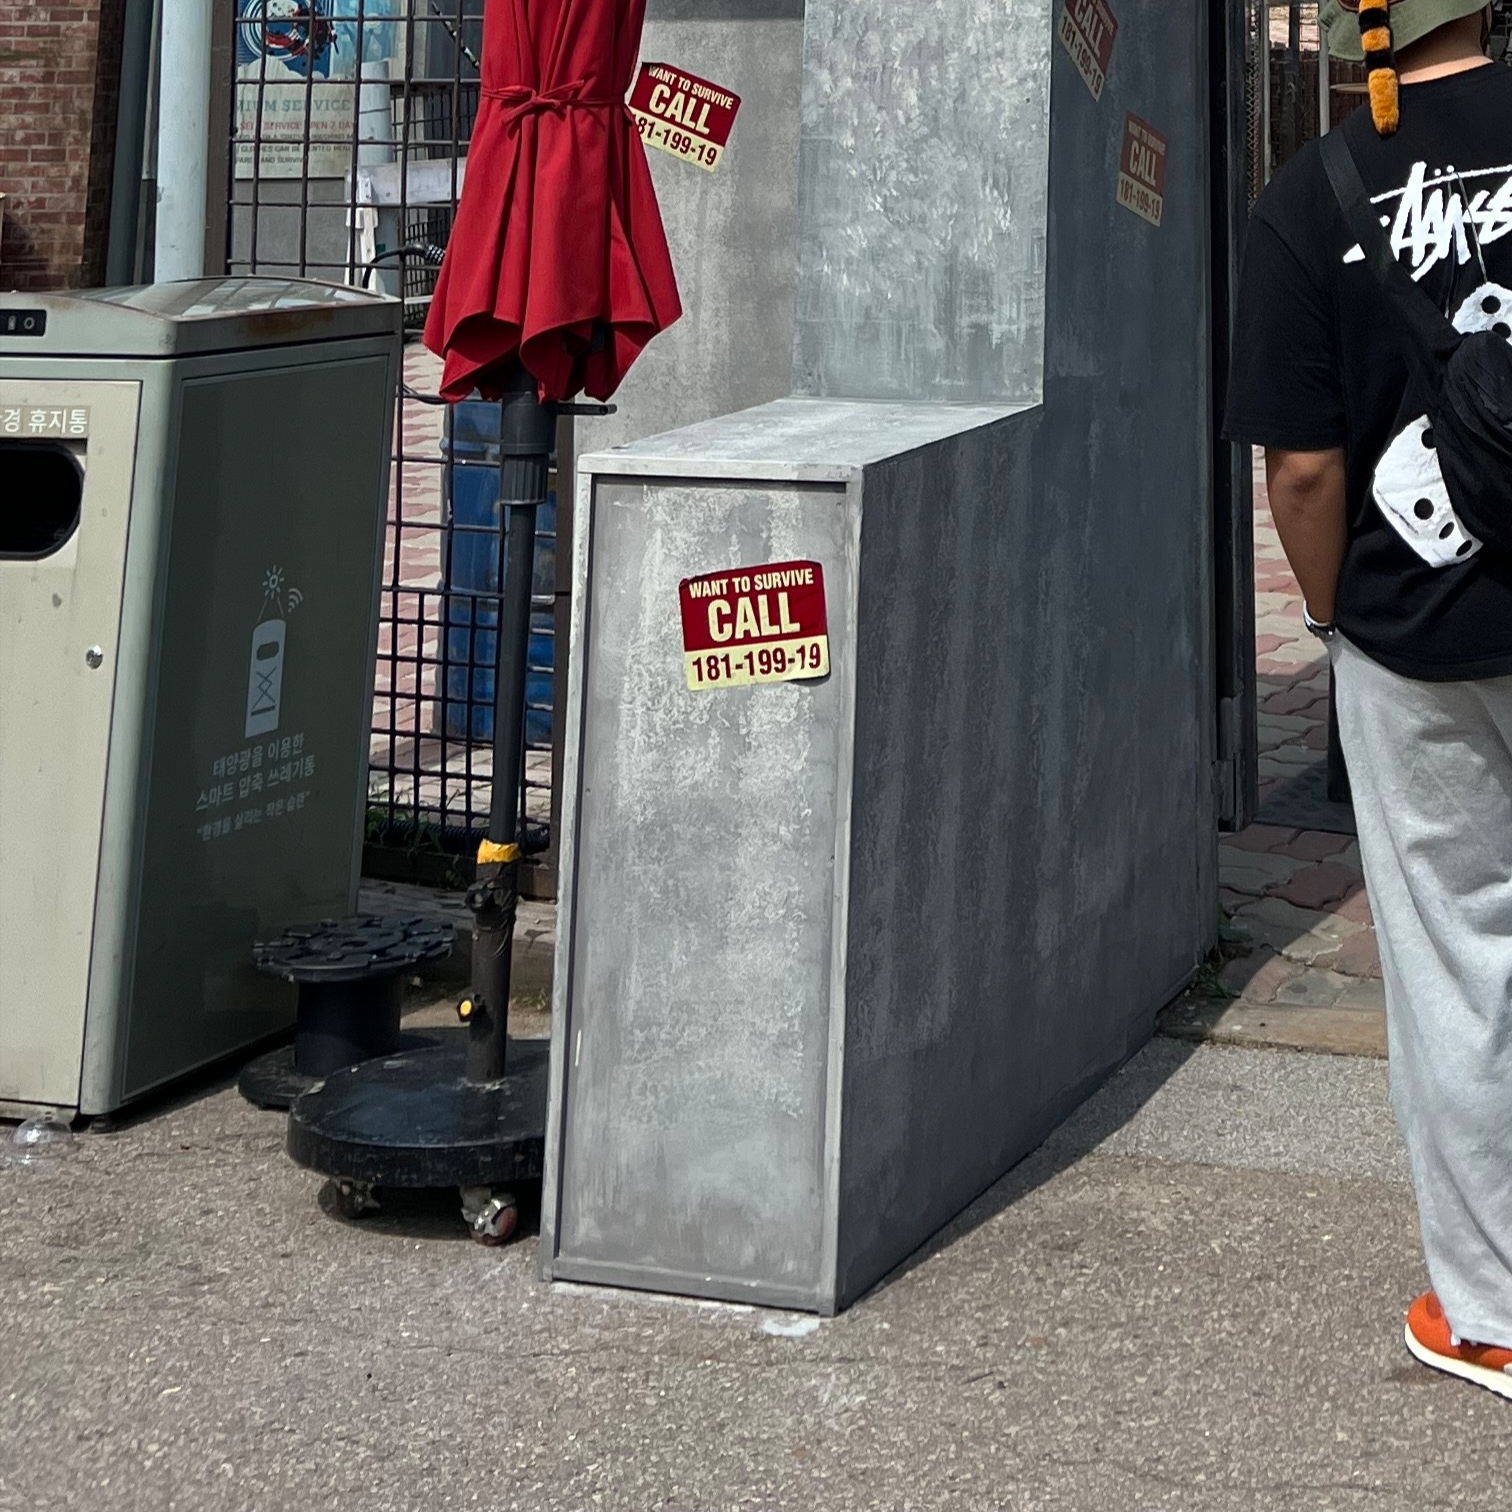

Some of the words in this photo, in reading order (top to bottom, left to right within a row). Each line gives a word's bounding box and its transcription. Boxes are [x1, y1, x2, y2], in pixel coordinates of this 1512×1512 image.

[1061, 16, 1102, 95] 181-199-19
[282, 99, 351, 112] SEVICE
[649, 66, 677, 86] WANT
[678, 77, 691, 91] TO
[691, 84, 734, 110] SURVIVE
[649, 84, 710, 135] CALL
[634, 113, 718, 166] 81-199-19
[1129, 140, 1157, 188] CALL
[28, 408, 88, 434] 휴지통
[689, 579, 728, 598] WANT
[732, 576, 750, 593] TO
[754, 568, 813, 591] SURVIVE
[708, 592, 800, 642] CALL
[692, 643, 821, 682] 181-199-19
[213, 745, 263, 778] 태양광을
[267, 732, 304, 761] 이용한
[195, 782, 234, 811] 스마트
[239, 772, 263, 799] 압축
[266, 754, 315, 787] 쓰레기통
